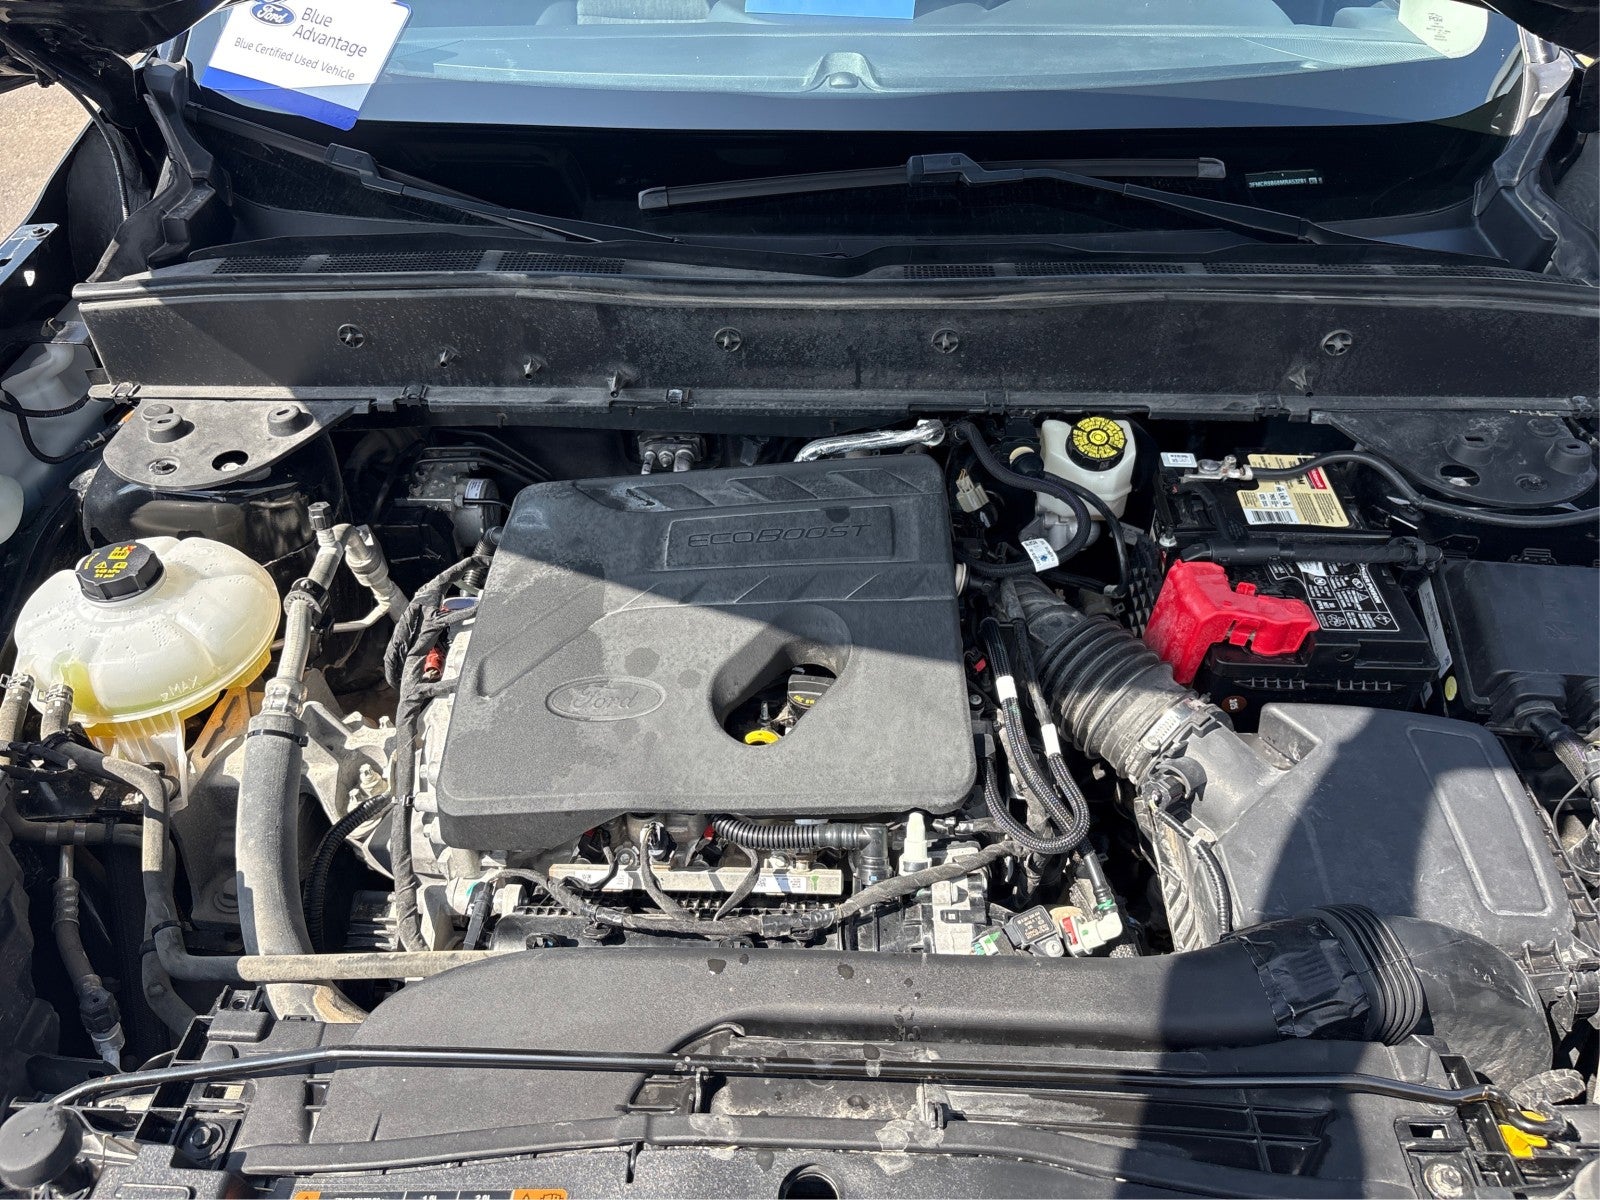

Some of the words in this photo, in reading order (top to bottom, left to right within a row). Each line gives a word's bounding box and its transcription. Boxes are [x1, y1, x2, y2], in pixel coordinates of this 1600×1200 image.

[256, 3, 286, 24] Ford
[301, 7, 333, 28] Blue
[292, 24, 368, 57] Advantage
[234, 37, 254, 51] Blue
[255, 43, 293, 62] Certified
[294, 55, 319, 69] Used
[320, 60, 356, 81] Vehicle
[687, 524, 872, 548] ECOBOOST
[569, 684, 640, 709] Ford
